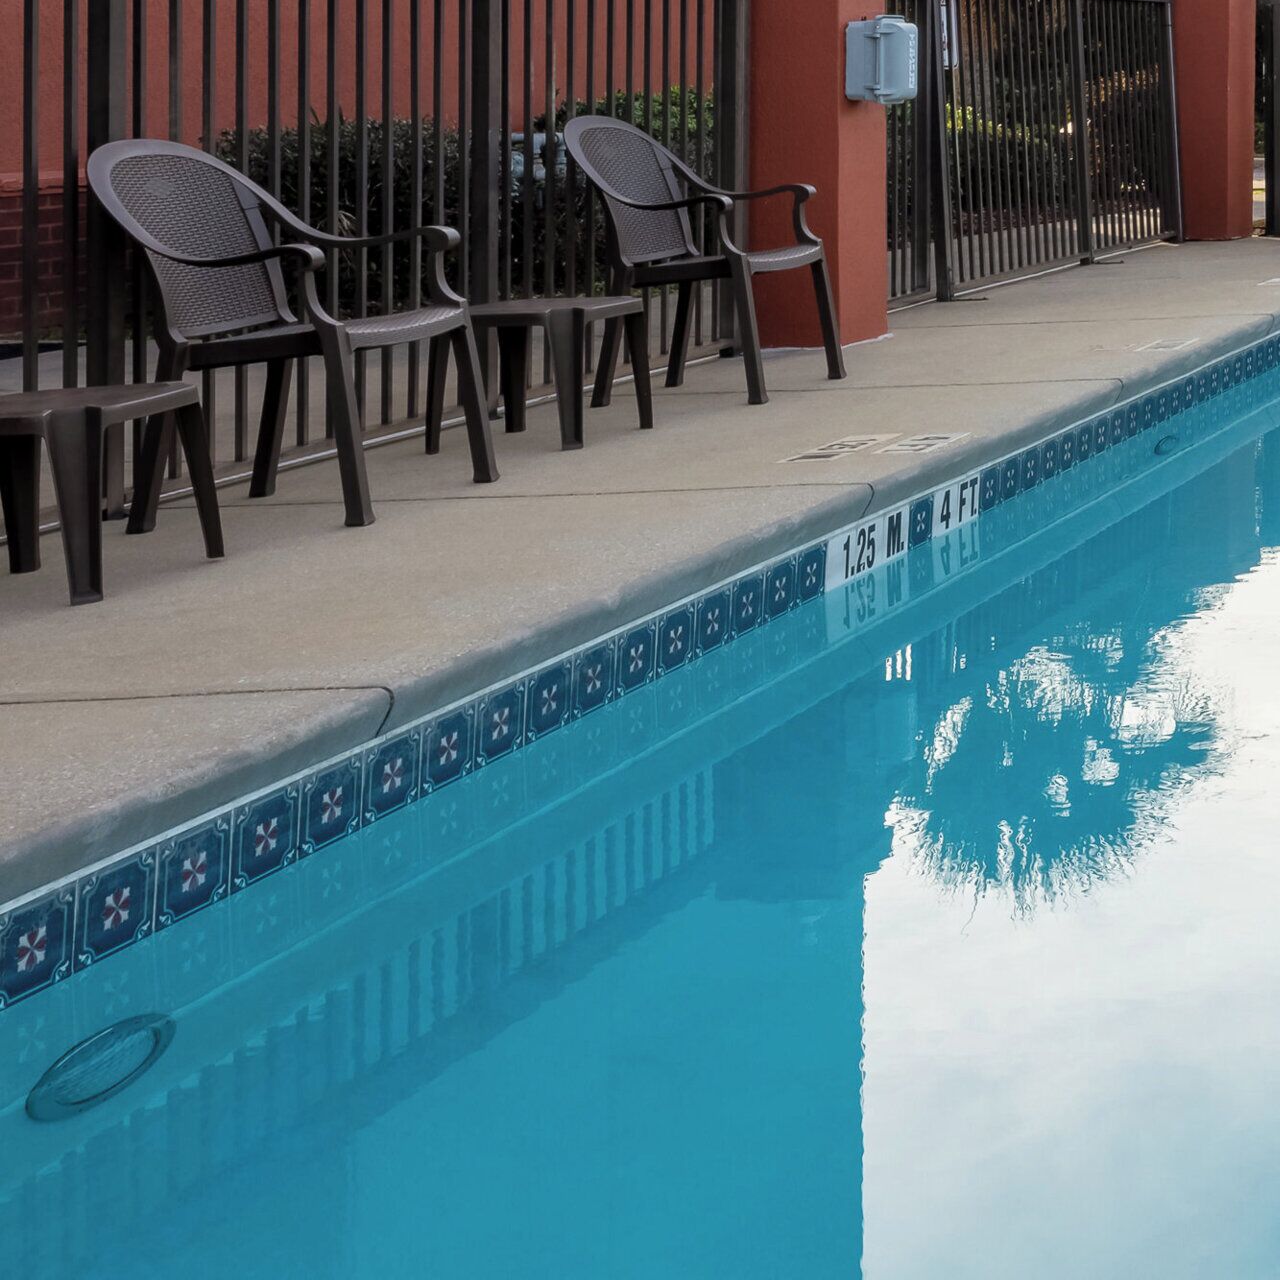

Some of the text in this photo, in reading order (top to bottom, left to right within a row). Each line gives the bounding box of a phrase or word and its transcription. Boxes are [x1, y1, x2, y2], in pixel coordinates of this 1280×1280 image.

[940, 476, 979, 530] 4 FT.
[843, 511, 904, 579] 1.25 M.
